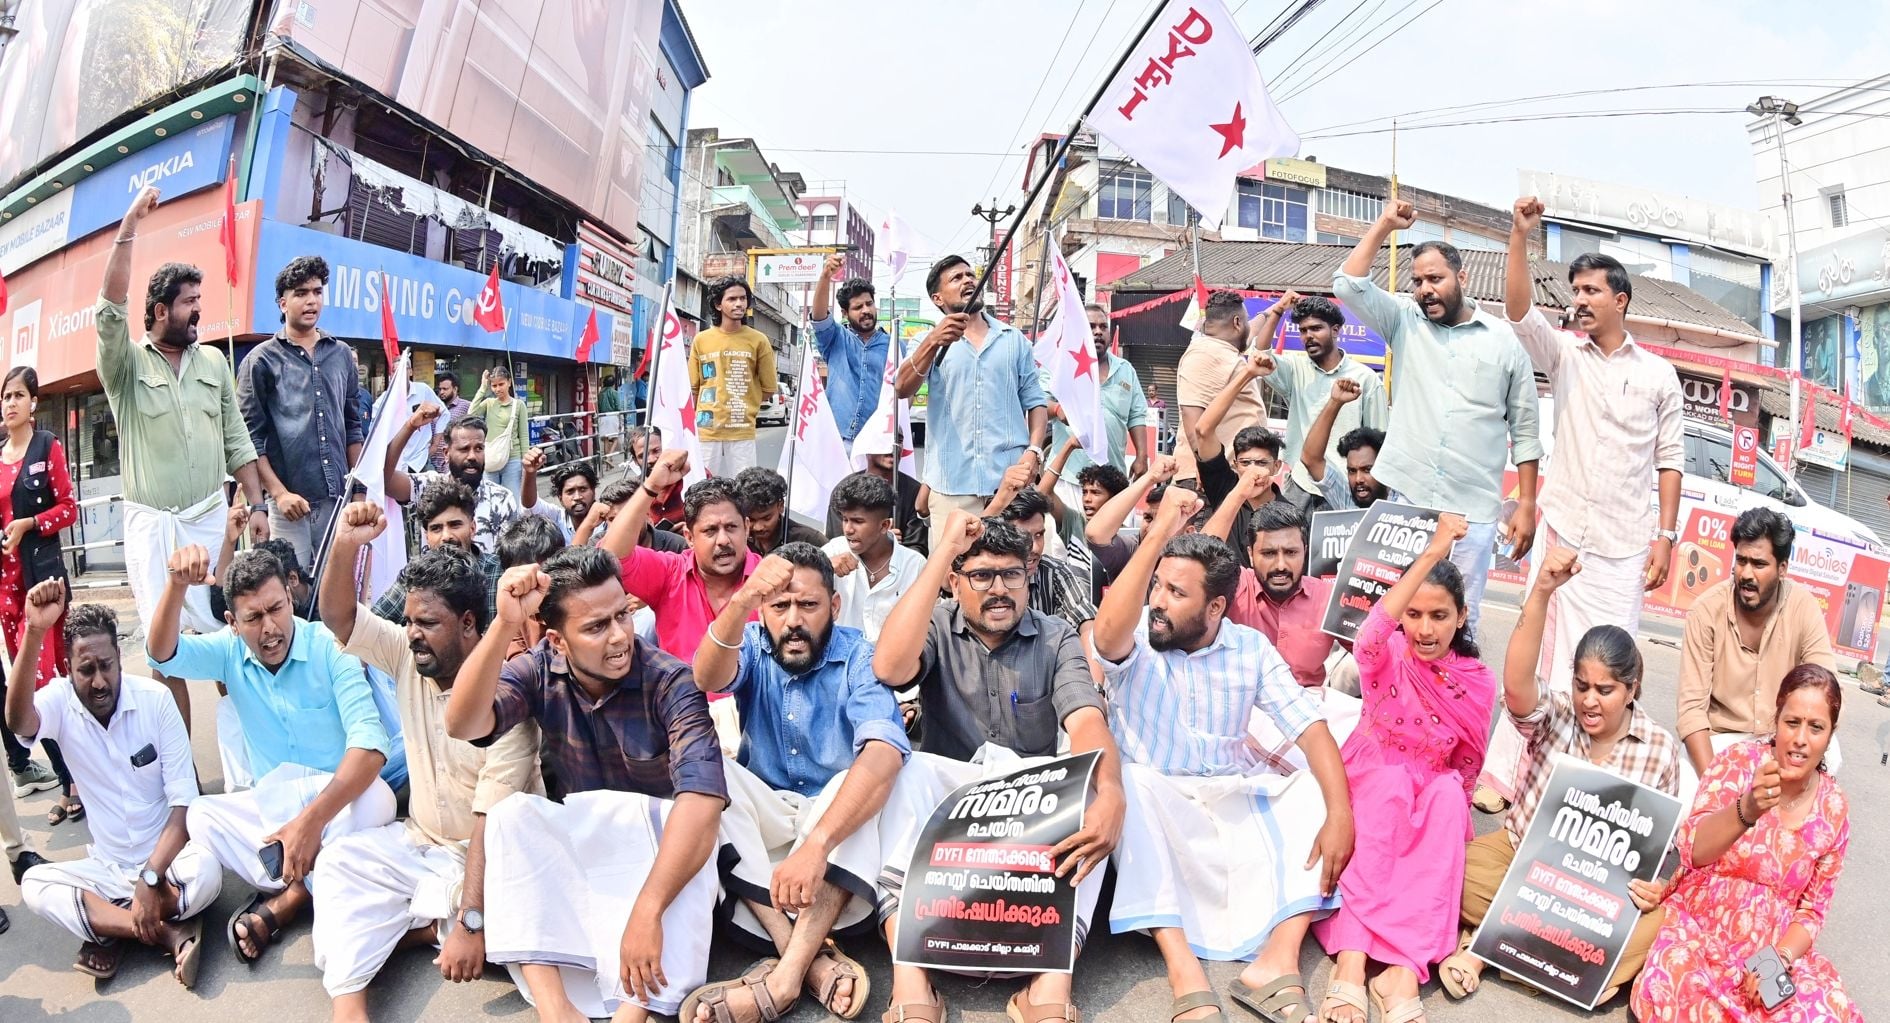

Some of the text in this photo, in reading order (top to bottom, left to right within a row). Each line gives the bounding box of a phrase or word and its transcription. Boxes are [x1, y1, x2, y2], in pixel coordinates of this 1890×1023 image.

[1117, 7, 1213, 121] DYFI
[128, 150, 194, 193] NOKIA
[1271, 170, 1320, 186] FOTOFOCUS
[0, 211, 65, 257] EW MOBILE BAZAAR
[177, 228, 193, 239] NEW
[193, 219, 222, 234] MOBILE
[997, 236, 1009, 302] SIDENCY
[324, 265, 434, 320] MSUNG
[48, 305, 97, 341] Xiaom
[445, 287, 512, 342] Gay
[1695, 404, 1734, 419] WORS
[1733, 461, 1755, 470] RIGHT
[1739, 455, 1750, 463] NO
[1733, 469, 1754, 479] TURN
[1366, 521, 1430, 555] സമര
[1697, 515, 1728, 542] 0%
[1355, 560, 1375, 576] DYFI
[1796, 546, 1848, 575] Mobiles
[965, 767, 1068, 796] ഡൽഹിയിൽ
[948, 785, 1058, 820] സമരം
[1563, 786, 1654, 838] ഡൽഹിയിൽ
[966, 817, 1025, 838] ചെയ്ത
[1549, 806, 1641, 872] സമരം
[934, 847, 1051, 871] DYFI നേതാക്കളെ
[1561, 852, 1609, 884] ചെയ്ത
[924, 868, 1056, 895] അറസ്റ്റ് ചെയ്തതിൽ
[1530, 866, 1555, 886] DYFI
[914, 895, 1060, 927] പ്രതിഷേധിക്കുക
[927, 940, 950, 950] DYFI
[950, 942, 990, 953] പാലക്കാട്
[1500, 904, 1607, 967] പ്രതിഷേധിക്കുക
[1500, 942, 1517, 957] DYFI
